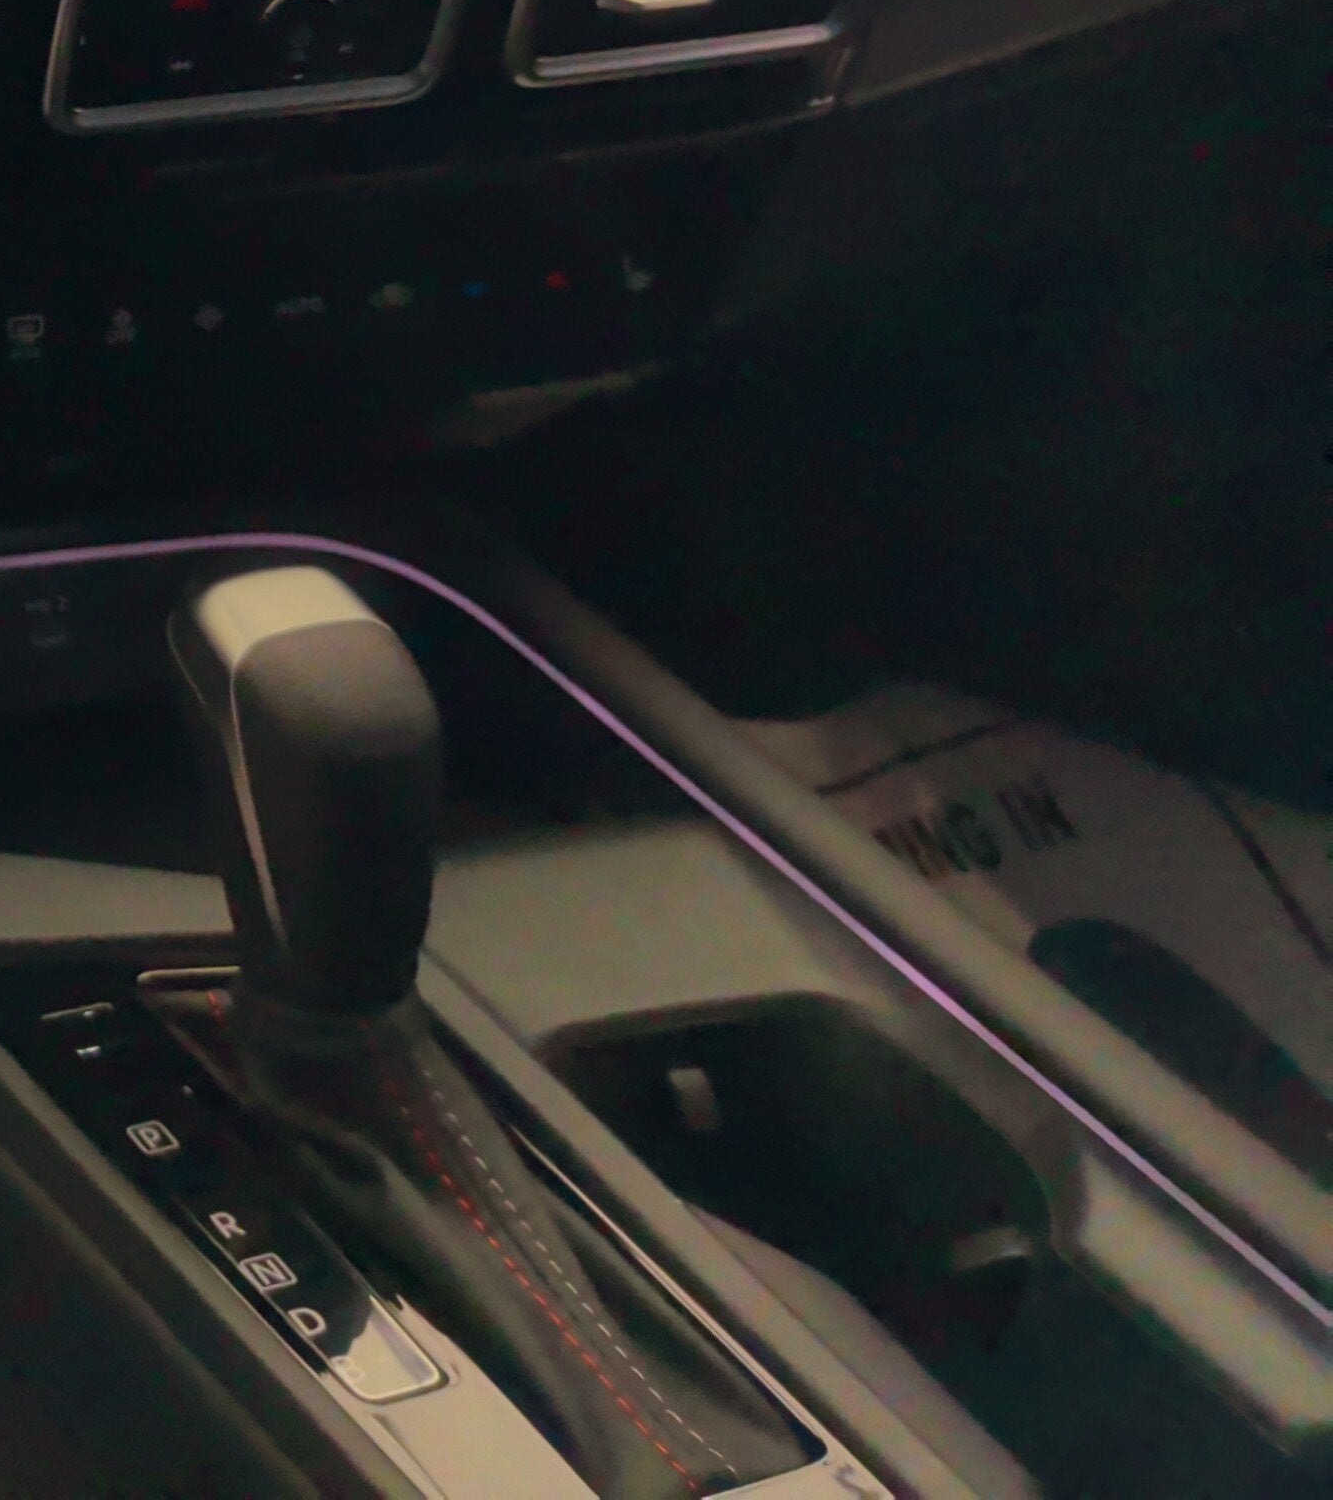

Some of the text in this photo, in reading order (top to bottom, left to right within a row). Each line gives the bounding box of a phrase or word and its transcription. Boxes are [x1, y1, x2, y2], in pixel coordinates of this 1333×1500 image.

[208, 1210, 247, 1239] R
[247, 1257, 289, 1287] N
[287, 1306, 328, 1337] D
